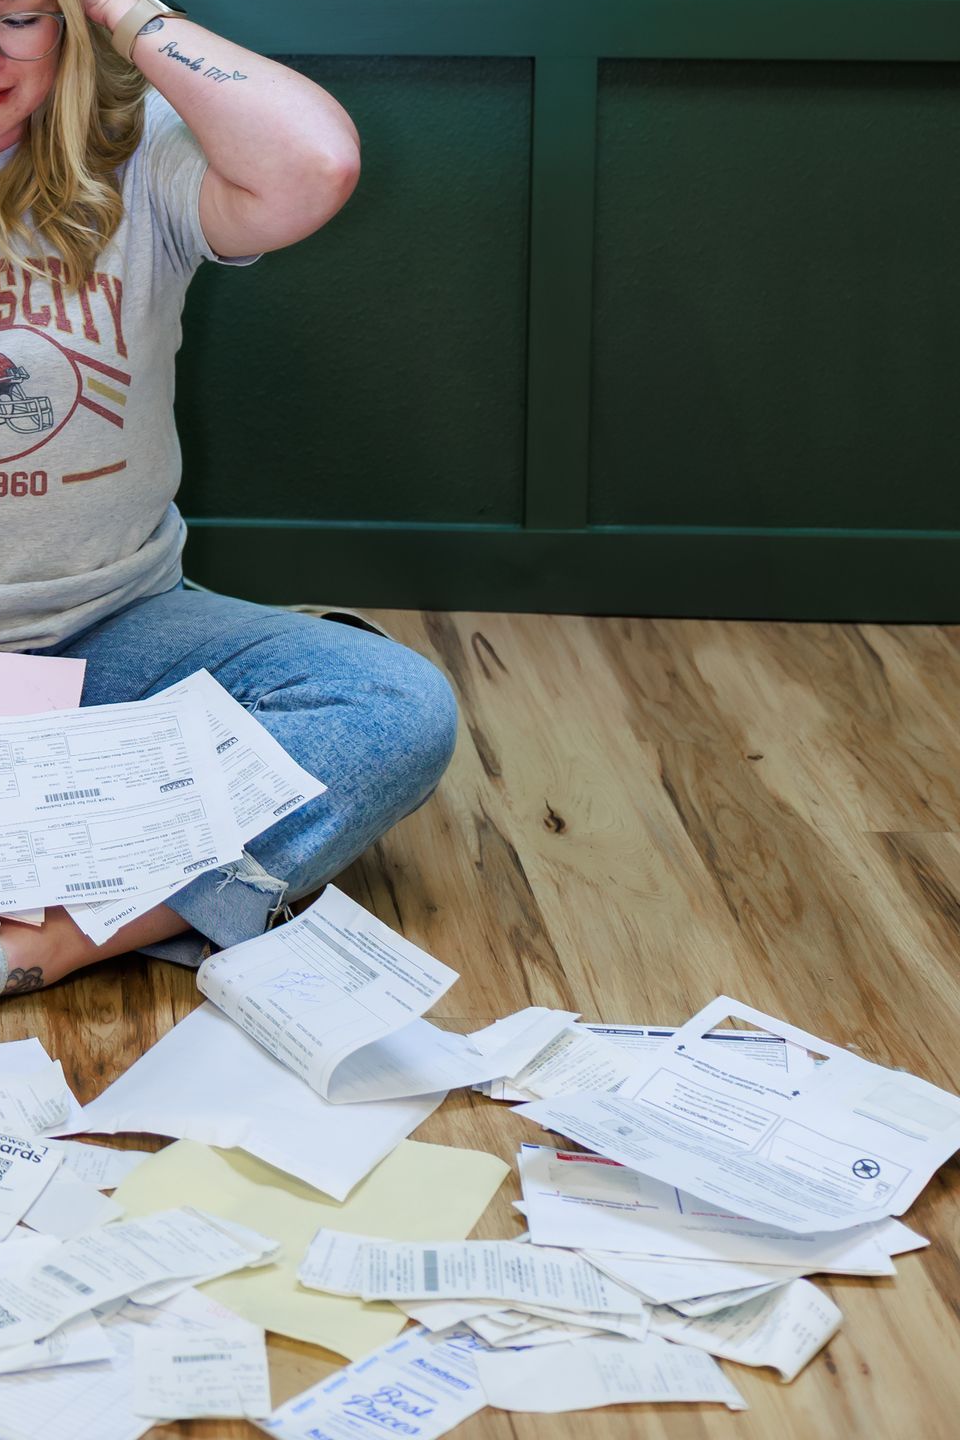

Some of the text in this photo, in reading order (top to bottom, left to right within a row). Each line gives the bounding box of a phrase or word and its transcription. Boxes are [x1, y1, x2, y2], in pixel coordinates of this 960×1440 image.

[158, 41, 204, 71] Proverbs
[61, 799, 75, 808] your
[85, 797, 97, 805] you
[98, 795, 114, 803] Thank
[33, 801, 62, 814] business!
[108, 886, 119, 894] you
[120, 884, 138, 893] Thank
[54, 891, 83, 903] business!
[83, 889, 97, 898] your
[370, 1384, 433, 1418] Best
[342, 1392, 421, 1436] Prices
